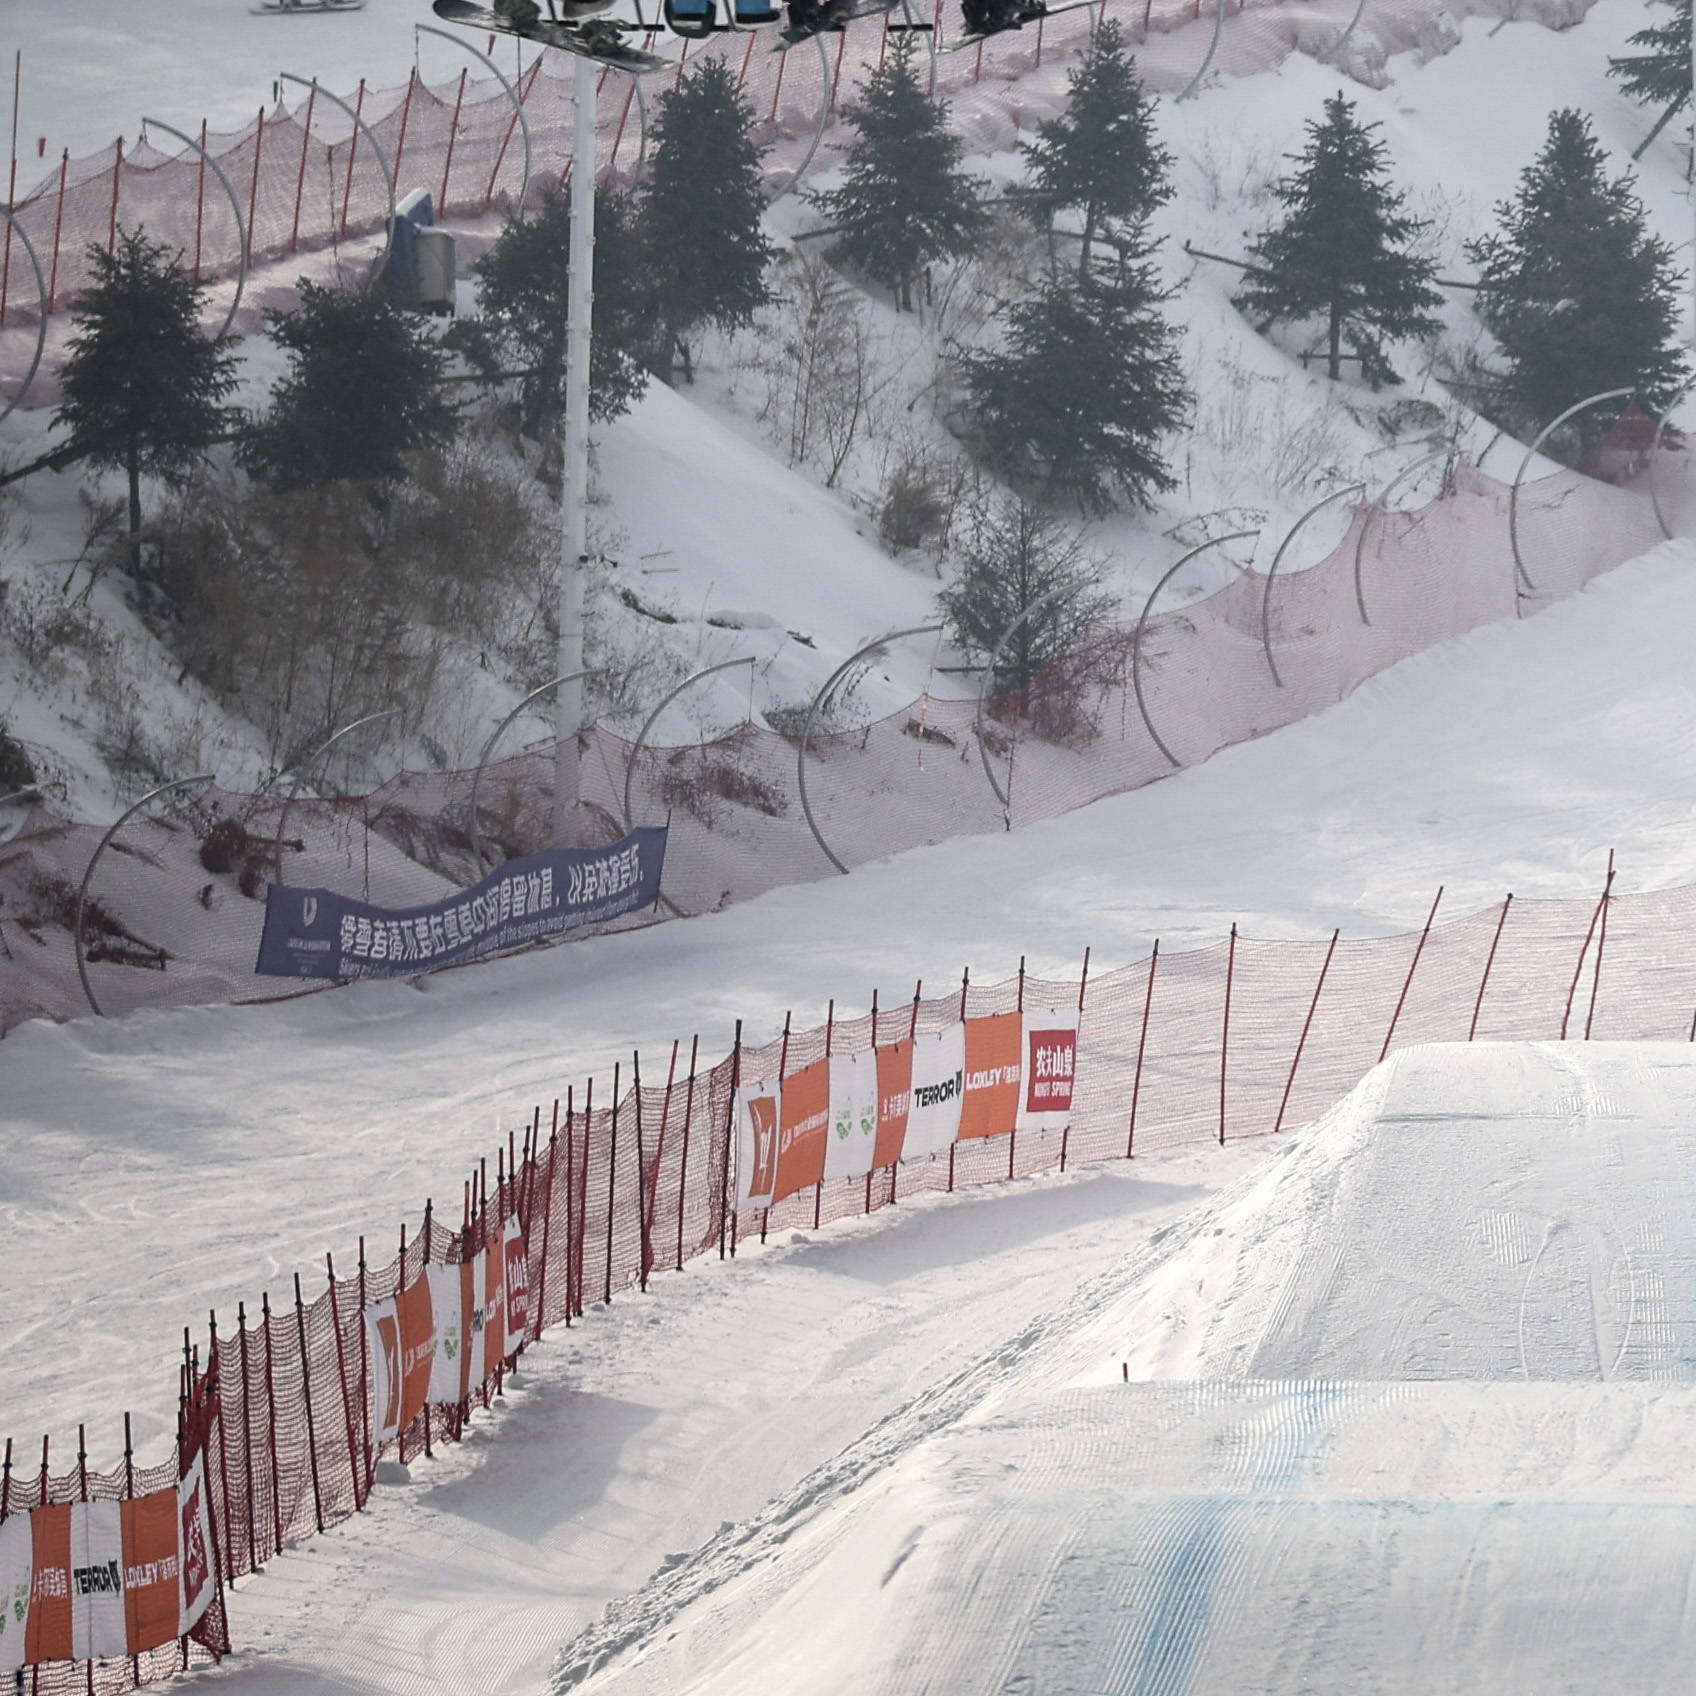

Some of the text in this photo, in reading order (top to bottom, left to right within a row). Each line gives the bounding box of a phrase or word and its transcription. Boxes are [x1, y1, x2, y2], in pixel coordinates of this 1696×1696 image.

[1036, 1044, 1073, 1078] 农夫山泉
[914, 1077, 956, 1109] TERROR
[965, 1067, 1003, 1091] LOXLEY
